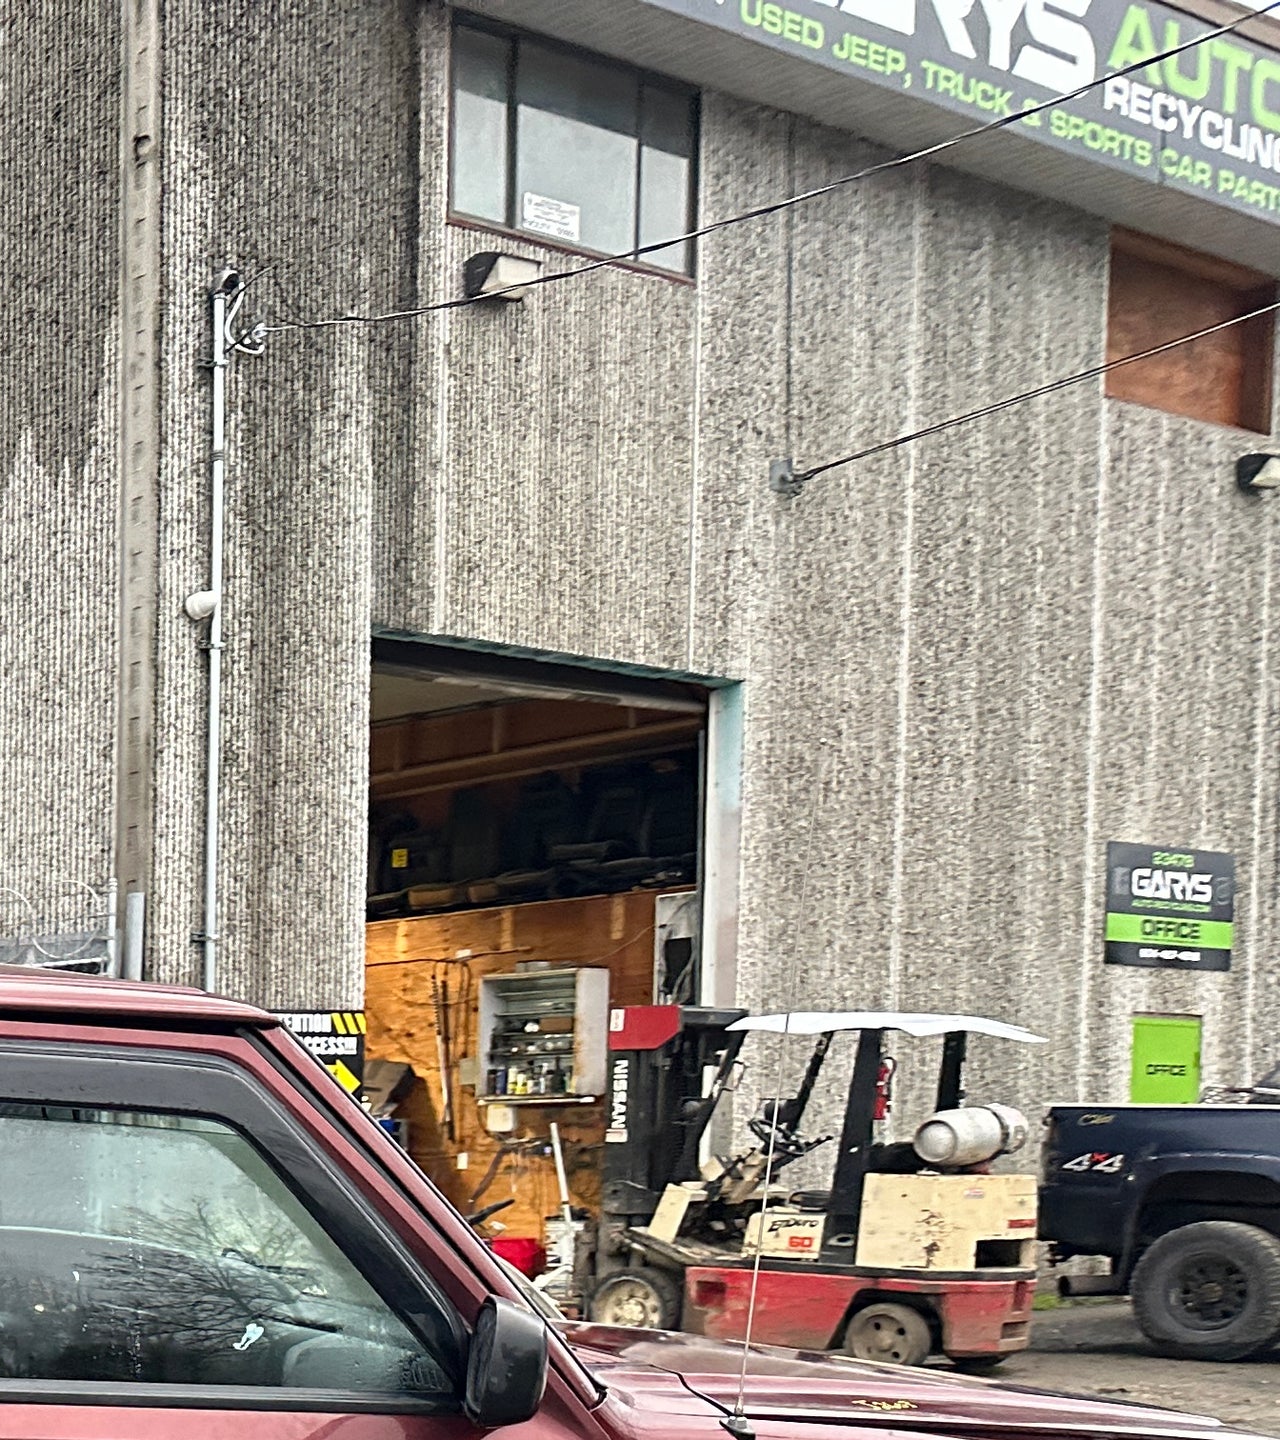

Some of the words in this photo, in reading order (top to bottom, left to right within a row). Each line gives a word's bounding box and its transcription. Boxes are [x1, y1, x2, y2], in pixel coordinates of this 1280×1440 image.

[740, 0, 825, 49] USED
[832, 32, 913, 89] JEEP,
[920, 59, 1014, 116] TRUCK
[1020, 98, 1042, 128] &
[1049, 109, 1154, 168] SPORTS
[1159, 148, 1213, 190] CAR
[1217, 168, 1280, 211] PART
[1131, 868, 1213, 903] GARYS
[1141, 918, 1201, 940] OFFICE
[1146, 1063, 1187, 1077] OFFICE
[611, 1059, 629, 1129] NISSAN
